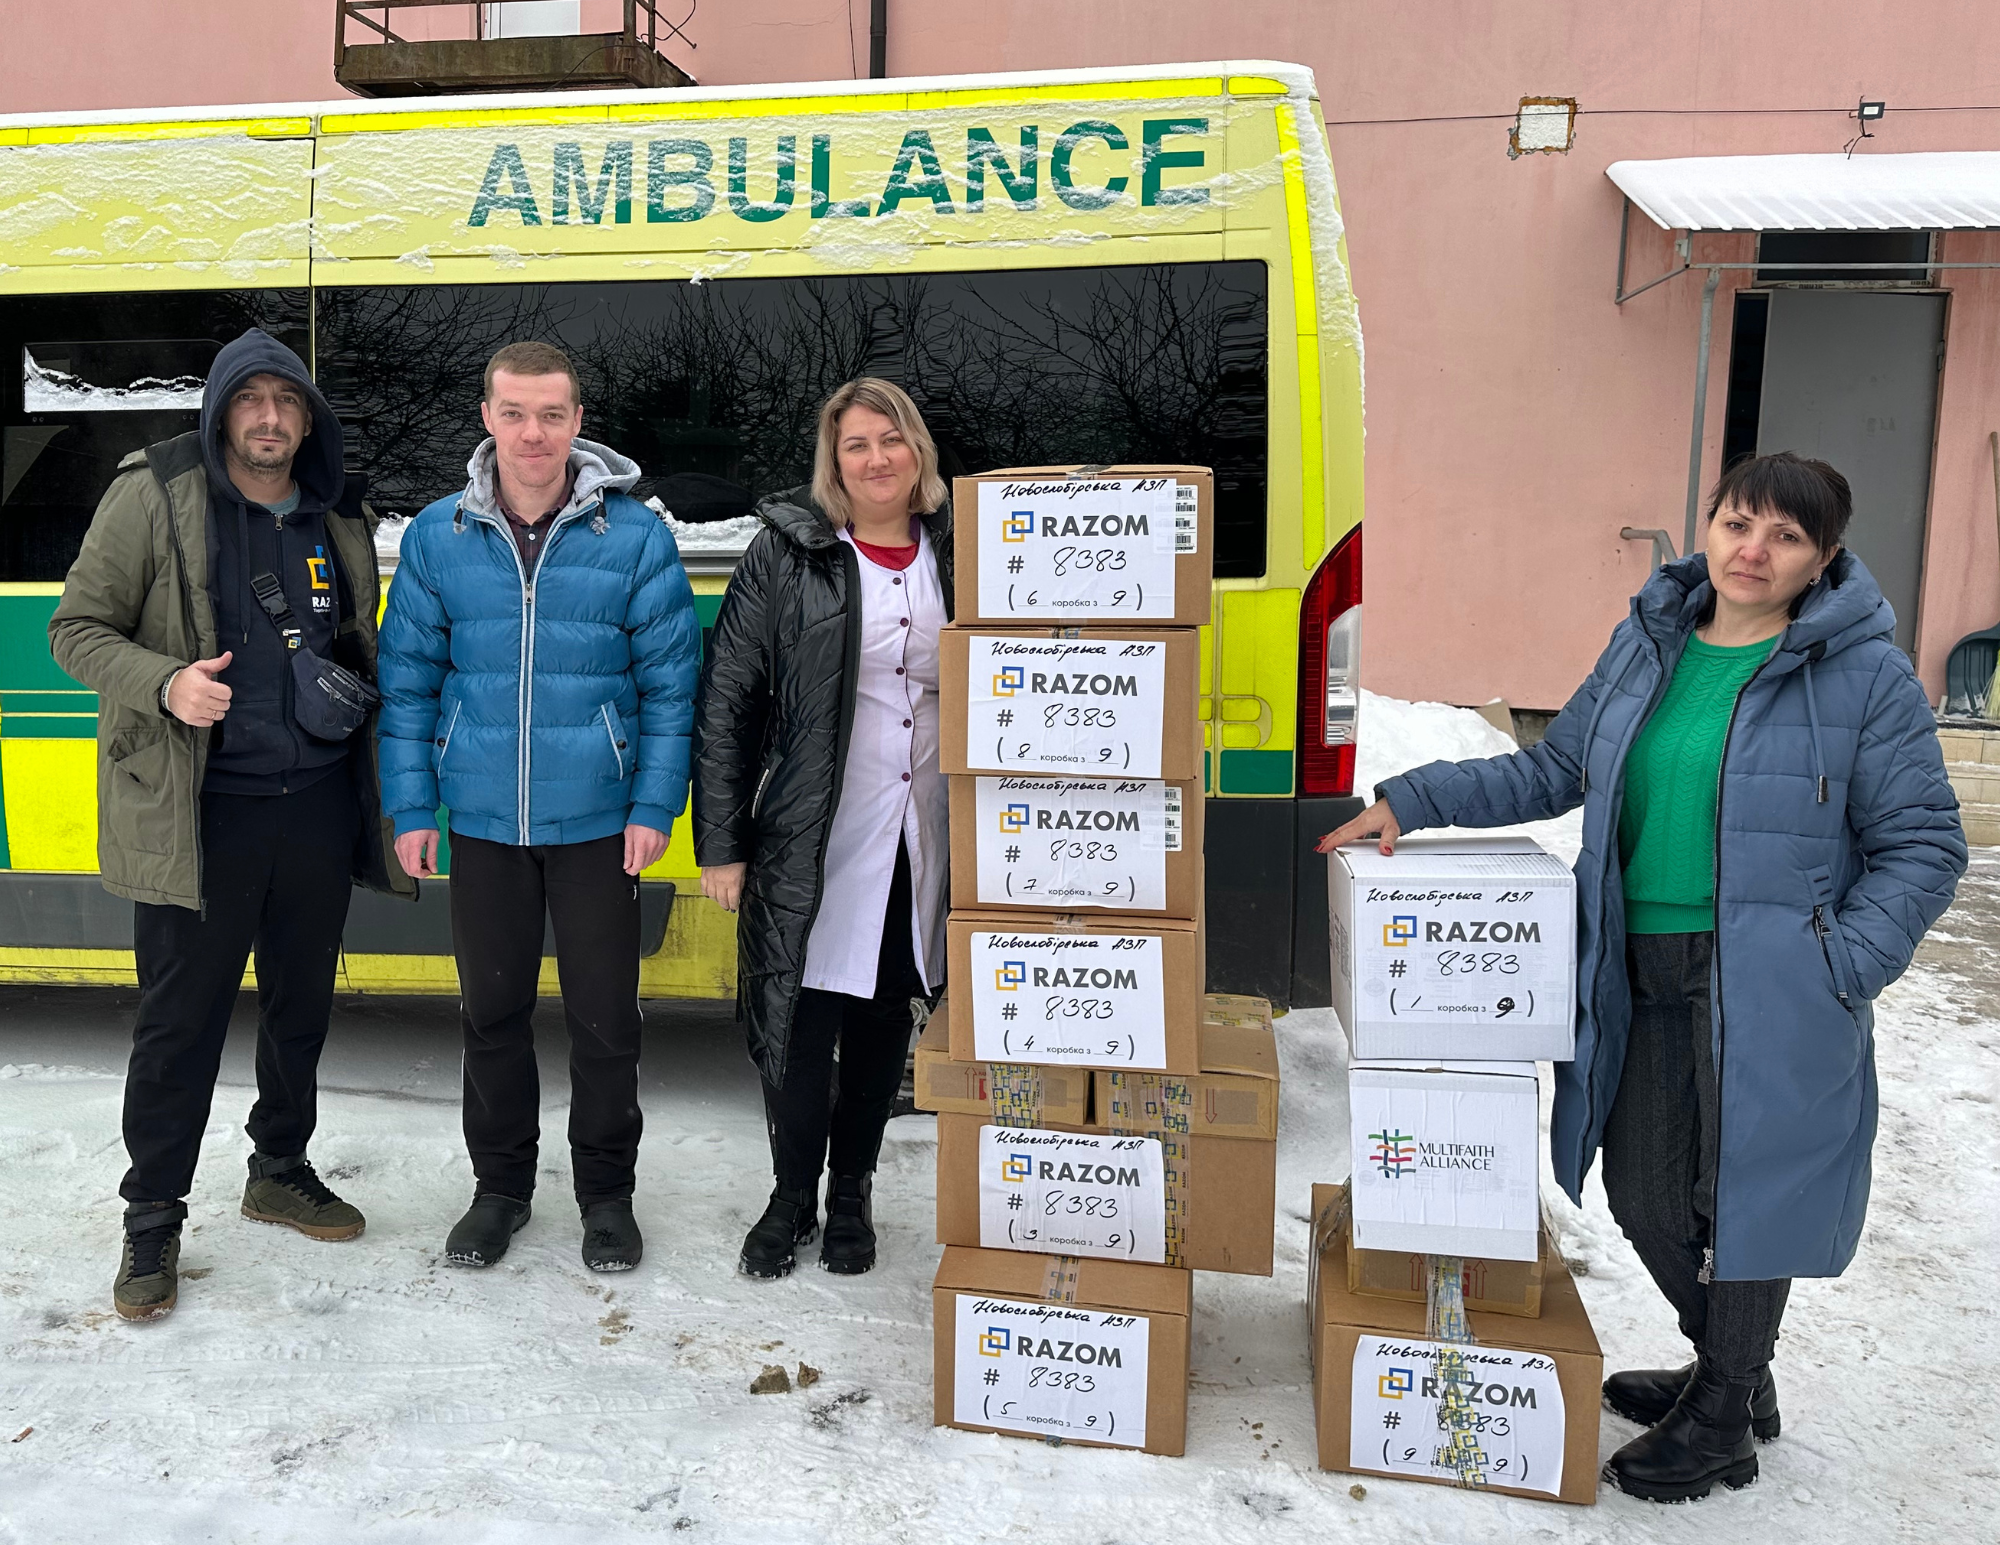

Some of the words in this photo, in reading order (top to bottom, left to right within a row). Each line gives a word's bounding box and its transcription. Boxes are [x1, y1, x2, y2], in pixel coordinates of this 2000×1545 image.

[467, 117, 1210, 227] AMBULANCE
[1042, 515, 1149, 537] RAZOM
[1007, 556, 1024, 574] #
[1054, 547, 1127, 576] 8383
[1052, 600, 1091, 608] коробка
[1032, 673, 1137, 696] RAZOM
[997, 710, 1013, 727] #
[1044, 703, 1115, 728] 8383
[1041, 755, 1078, 763] коробка
[1038, 810, 1140, 831] RAZOM
[1005, 846, 1020, 862] #
[1051, 839, 1117, 861] 8383
[1426, 922, 1541, 942] RAZOM
[1389, 960, 1407, 977] #
[1437, 950, 1520, 976] 8383
[1034, 967, 1137, 989] RAZOM
[1002, 1003, 1017, 1020] #
[1046, 996, 1113, 1020] 8383
[1438, 1005, 1478, 1013] коробка
[1047, 1046, 1084, 1054] коробка
[1419, 1142, 1495, 1158] MULTIFAITH
[1039, 1161, 1140, 1187] RAZOM
[1420, 1156, 1492, 1171] ALLIANCE
[1008, 1194, 1023, 1210] #
[1045, 1191, 1117, 1218] 8383
[1050, 1236, 1086, 1245] коробка
[1018, 1336, 1122, 1368] RAZOM
[984, 1369, 999, 1386] #
[1029, 1367, 1095, 1392] 8383
[1422, 1376, 1537, 1409] RAZOM
[1027, 1415, 1063, 1425] коробка
[1383, 1411, 1401, 1429] #
